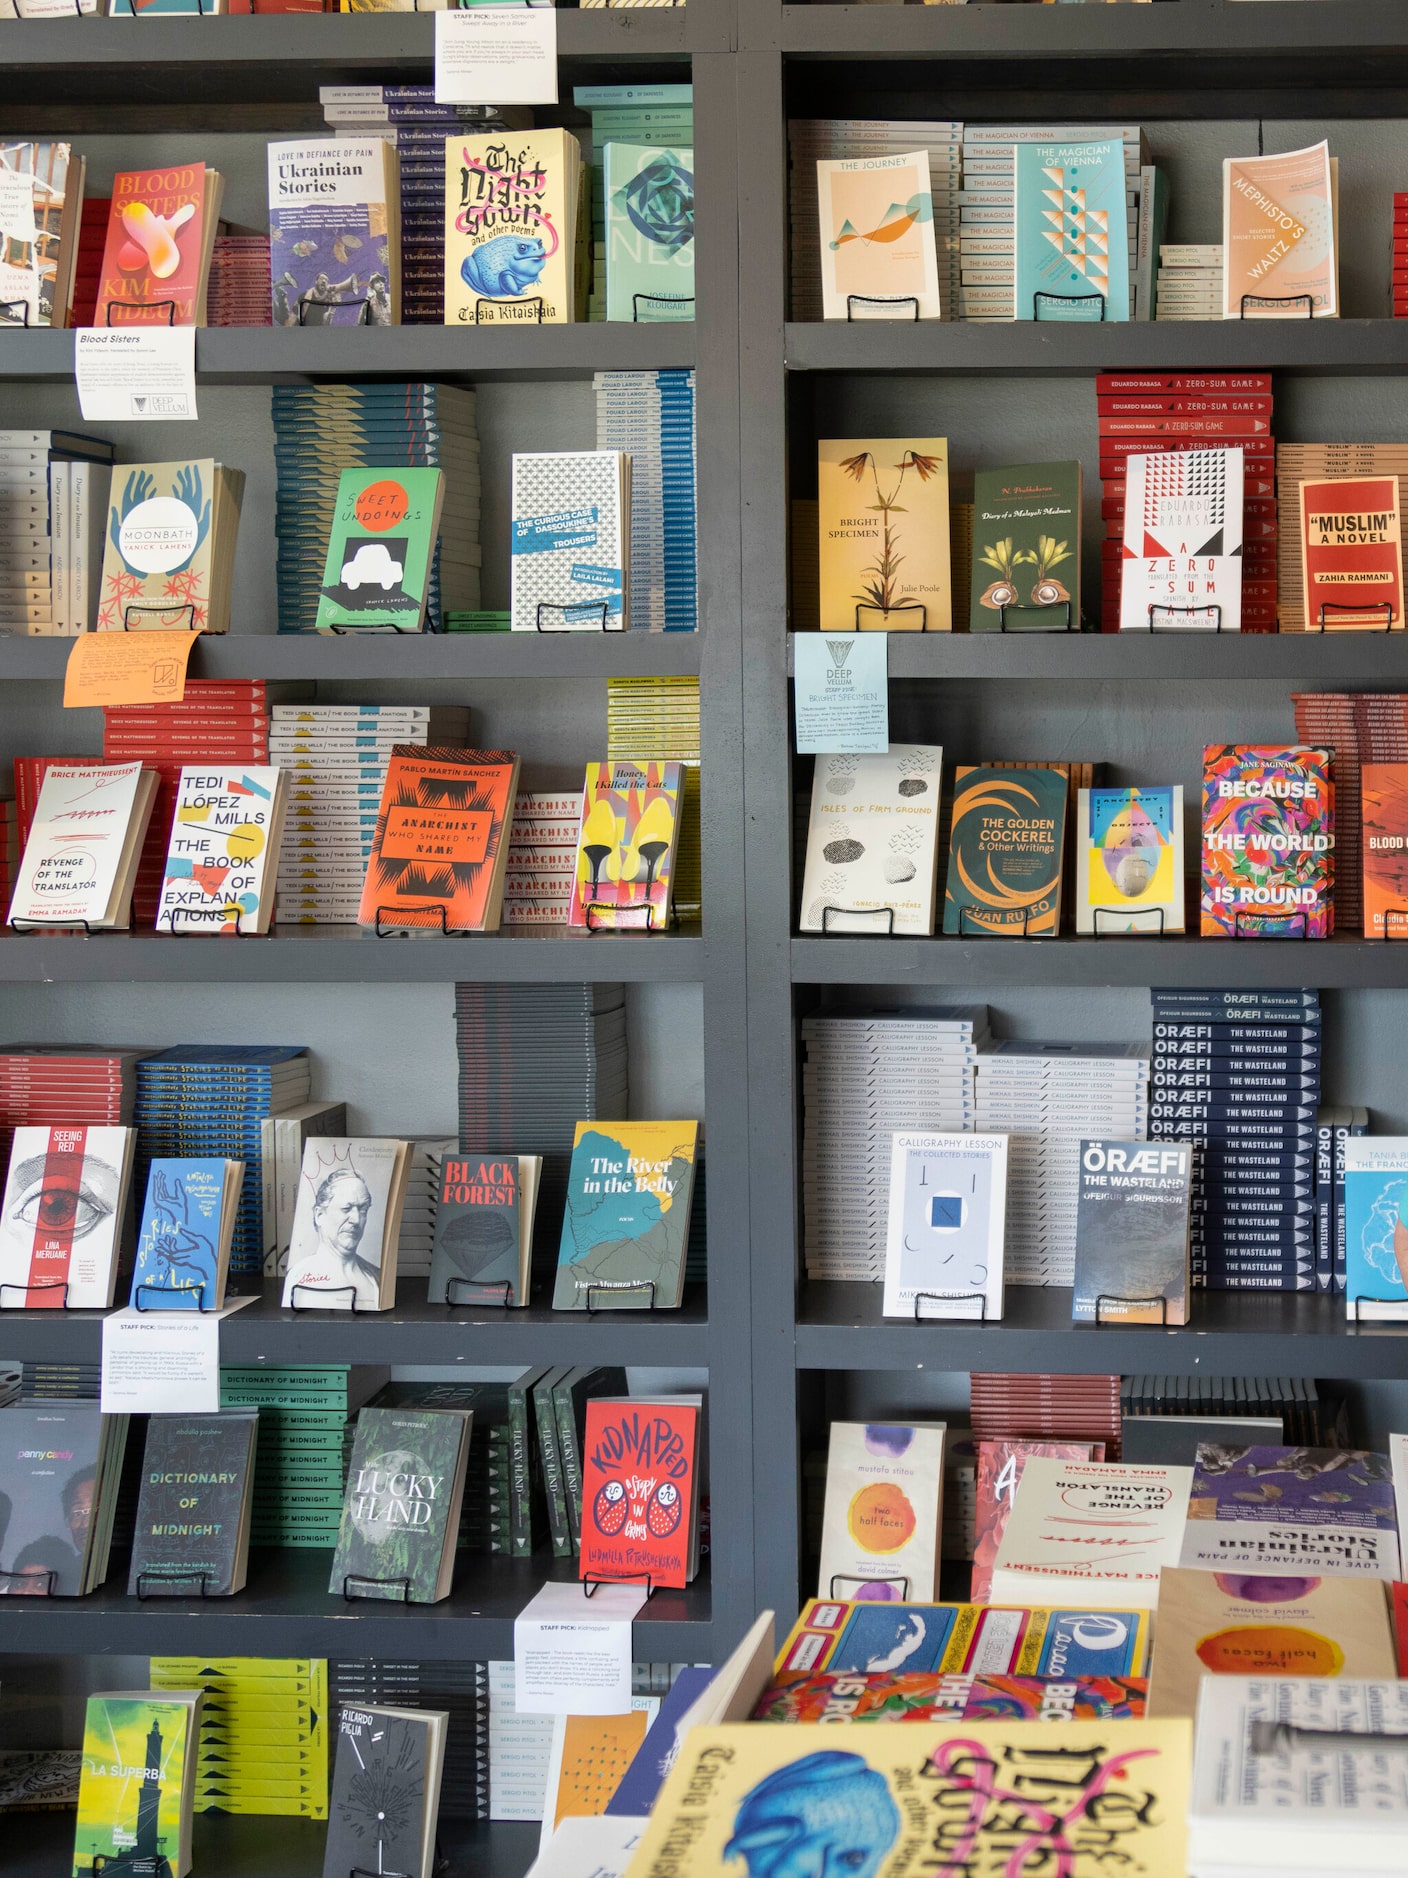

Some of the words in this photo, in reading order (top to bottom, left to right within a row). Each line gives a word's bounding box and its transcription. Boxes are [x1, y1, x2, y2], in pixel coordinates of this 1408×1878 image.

[278, 152, 294, 161] LOVE
[296, 152, 304, 160] IN
[307, 151, 340, 160] DEFIANCE
[342, 150, 352, 158] OF
[354, 149, 373, 157] PAIN
[1037, 148, 1055, 157] THE
[1058, 145, 1110, 157] MAGICIAN
[486, 143, 530, 173] The
[840, 161, 862, 170] THE
[865, 157, 907, 170] JOURNEY
[1045, 157, 1060, 166] OF
[1063, 156, 1102, 166] VIENNA
[278, 162, 363, 179] Ukrainian
[118, 169, 195, 195] BLOOD
[278, 180, 337, 195] Stories
[460, 162, 547, 205] Night
[1232, 178, 1305, 238] MEPHISTO'S
[1247, 240, 1290, 279] WALTZ
[103, 278, 151, 297] KIM
[80, 335, 108, 344] Blood
[109, 335, 140, 345] Sisters
[347, 492, 401, 508] SWEET
[342, 508, 424, 522] UNDOINGS
[516, 519, 534, 530] THE
[536, 513, 569, 527] CURIOUS
[571, 508, 593, 520] CASE
[516, 528, 529, 536] OF
[535, 516, 594, 533] DASSOUKINE'S
[840, 518, 878, 527] BRIGHT
[125, 529, 195, 540] MOONBATH
[553, 534, 596, 548] TROUSERS
[828, 530, 879, 539] SPECIMEN
[1321, 534, 1330, 543] A
[1334, 532, 1387, 543] NOVEL
[1320, 574, 1345, 583] ZAHIA
[1347, 572, 1389, 582] RAHMANI
[826, 670, 852, 678] DEEP
[78, 766, 138, 778] MATTHIEUSSENT
[400, 765, 426, 773] PABLO
[428, 765, 458, 776] MARTÍN
[460, 766, 501, 777] SÁNCHEZ
[183, 776, 223, 789] TEDI
[595, 781, 599, 789] I
[600, 780, 628, 789] Killed
[629, 780, 645, 789] the
[647, 780, 667, 789] Cats
[1219, 782, 1316, 798] BECAUSE
[183, 793, 240, 809] LÓPEZ
[215, 813, 265, 825] MILLS
[401, 818, 478, 830] ANARCHIST
[982, 818, 1004, 828] THE
[1008, 819, 1054, 829] GOLDEN
[980, 830, 1054, 843] COCKEREL
[1204, 833, 1247, 850] THE
[1252, 833, 1327, 851] WORLD
[1369, 836, 1403, 849] BLOOD
[175, 839, 210, 851] THE
[416, 845, 453, 854] NAME
[40, 858, 84, 867] REVENGE
[202, 857, 255, 868] BOOK
[34, 880, 96, 890] TRANSLATOR
[231, 877, 255, 888] OF
[164, 891, 246, 904] EXPLAN-
[1215, 887, 1237, 903] IS
[1240, 887, 1318, 905] ROUND
[1230, 1029, 1244, 1038] THE
[1246, 1029, 1288, 1038] WASTELAND
[53, 1131, 82, 1142] SEEING
[58, 1142, 74, 1152] RED
[898, 1138, 967, 1150] CALLIGRAPHY
[971, 1139, 1002, 1149] LESSON
[590, 1158, 623, 1174] The
[625, 1158, 672, 1174] River
[445, 1162, 514, 1185] BLACK
[583, 1178, 600, 1194] in
[604, 1178, 632, 1193] the
[634, 1177, 677, 1196] Belly
[1084, 1175, 1107, 1185] THE
[1110, 1177, 1184, 1189] WASTELAND
[443, 1186, 515, 1206] FOREST
[227, 1376, 277, 1385] DICTIONARY
[150, 1472, 237, 1485] DICTIONARY
[354, 1469, 444, 1499] LUCKY
[179, 1496, 198, 1510] OF
[357, 1496, 433, 1527] HAND
[152, 1523, 222, 1537] MIDNIGHT
[342, 1710, 373, 1725] RICARDO
[341, 1722, 362, 1735] PIGLIA
[91, 1763, 106, 1776] LA
[109, 1765, 168, 1781] SUPERBA
